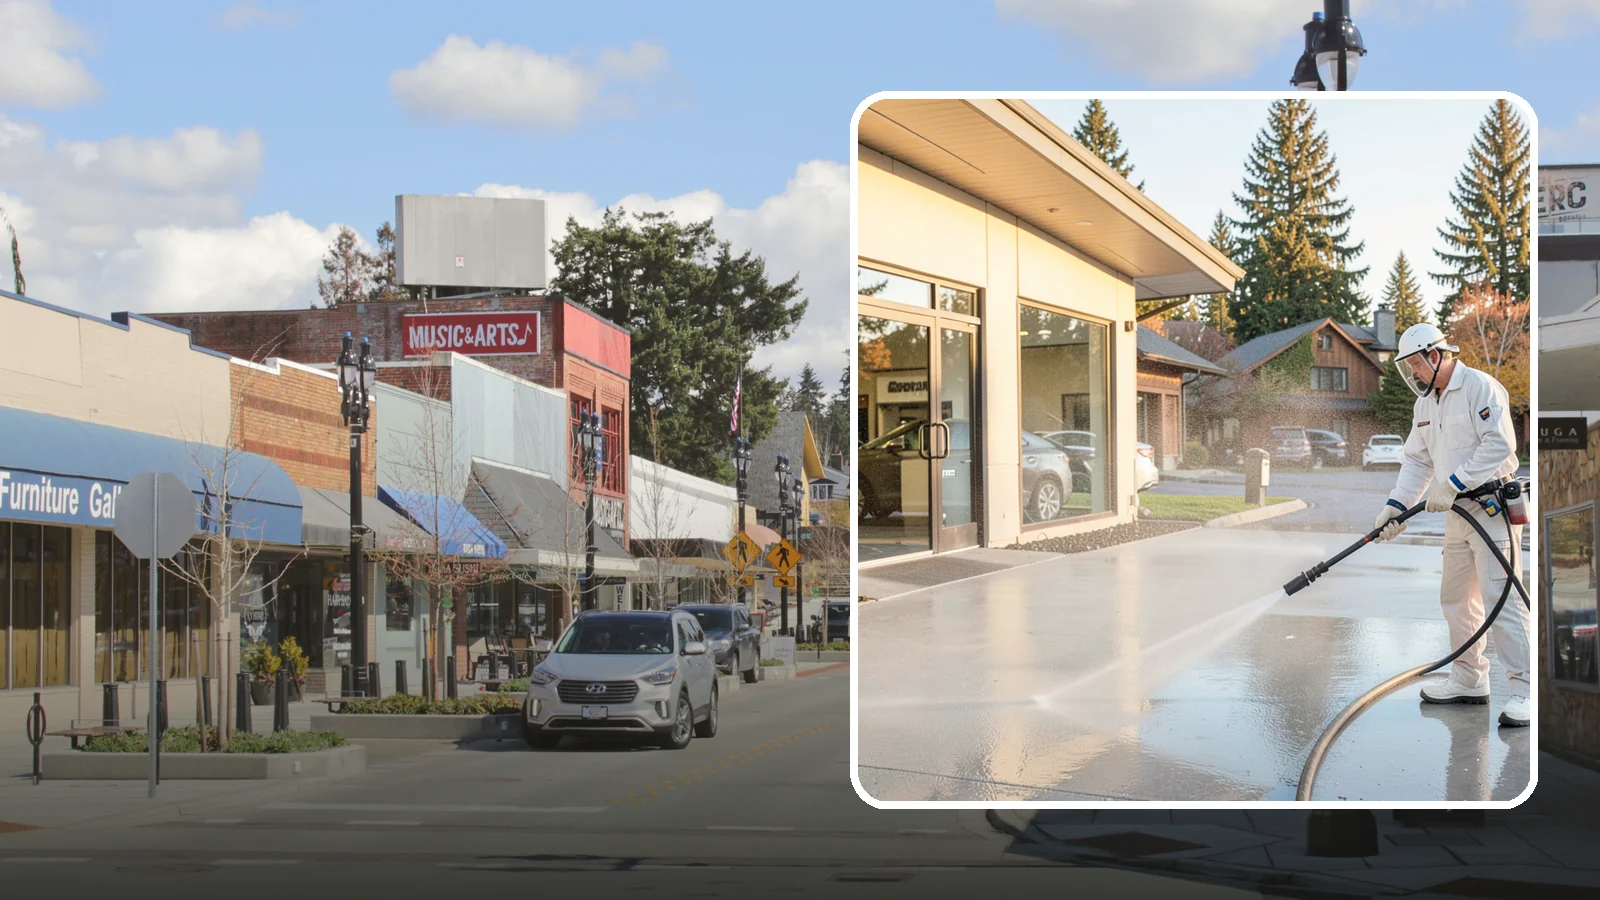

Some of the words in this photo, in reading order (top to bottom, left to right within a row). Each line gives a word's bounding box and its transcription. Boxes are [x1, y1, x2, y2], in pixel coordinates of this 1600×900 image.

[0, 471, 79, 515] Furniture
[89, 482, 121, 519] Gal
[453, 563, 479, 574] SUSHI
